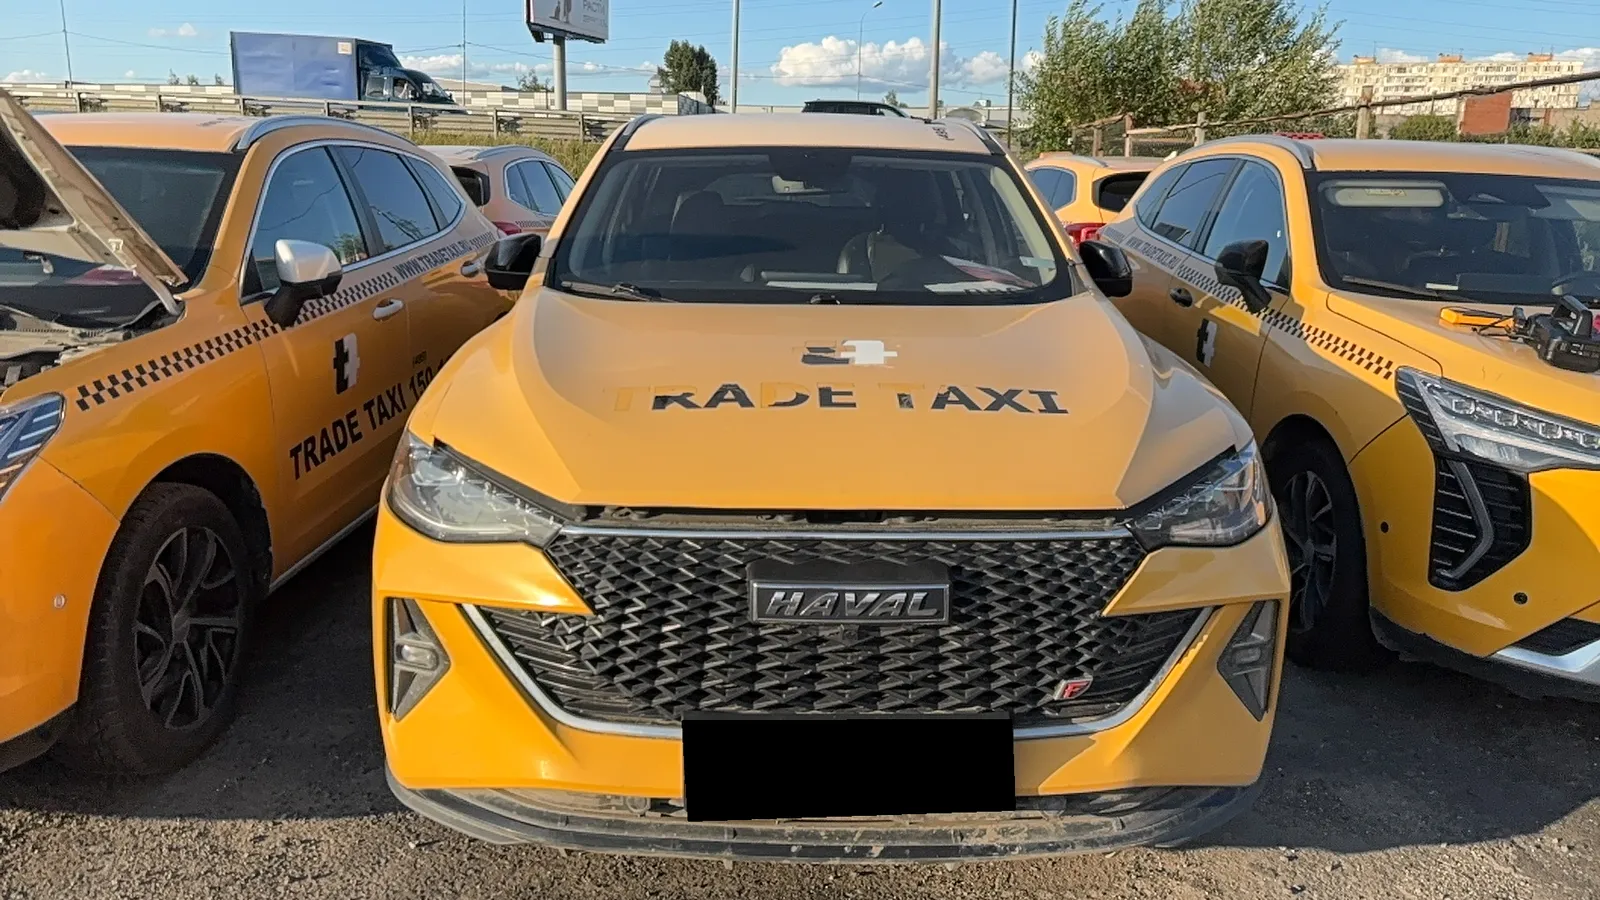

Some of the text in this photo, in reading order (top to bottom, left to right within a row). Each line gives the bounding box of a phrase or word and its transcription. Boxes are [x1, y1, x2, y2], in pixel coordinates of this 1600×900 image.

[289, 408, 363, 481] TRADE
[363, 382, 408, 431] TAXI
[765, 591, 938, 617] HAVAL
